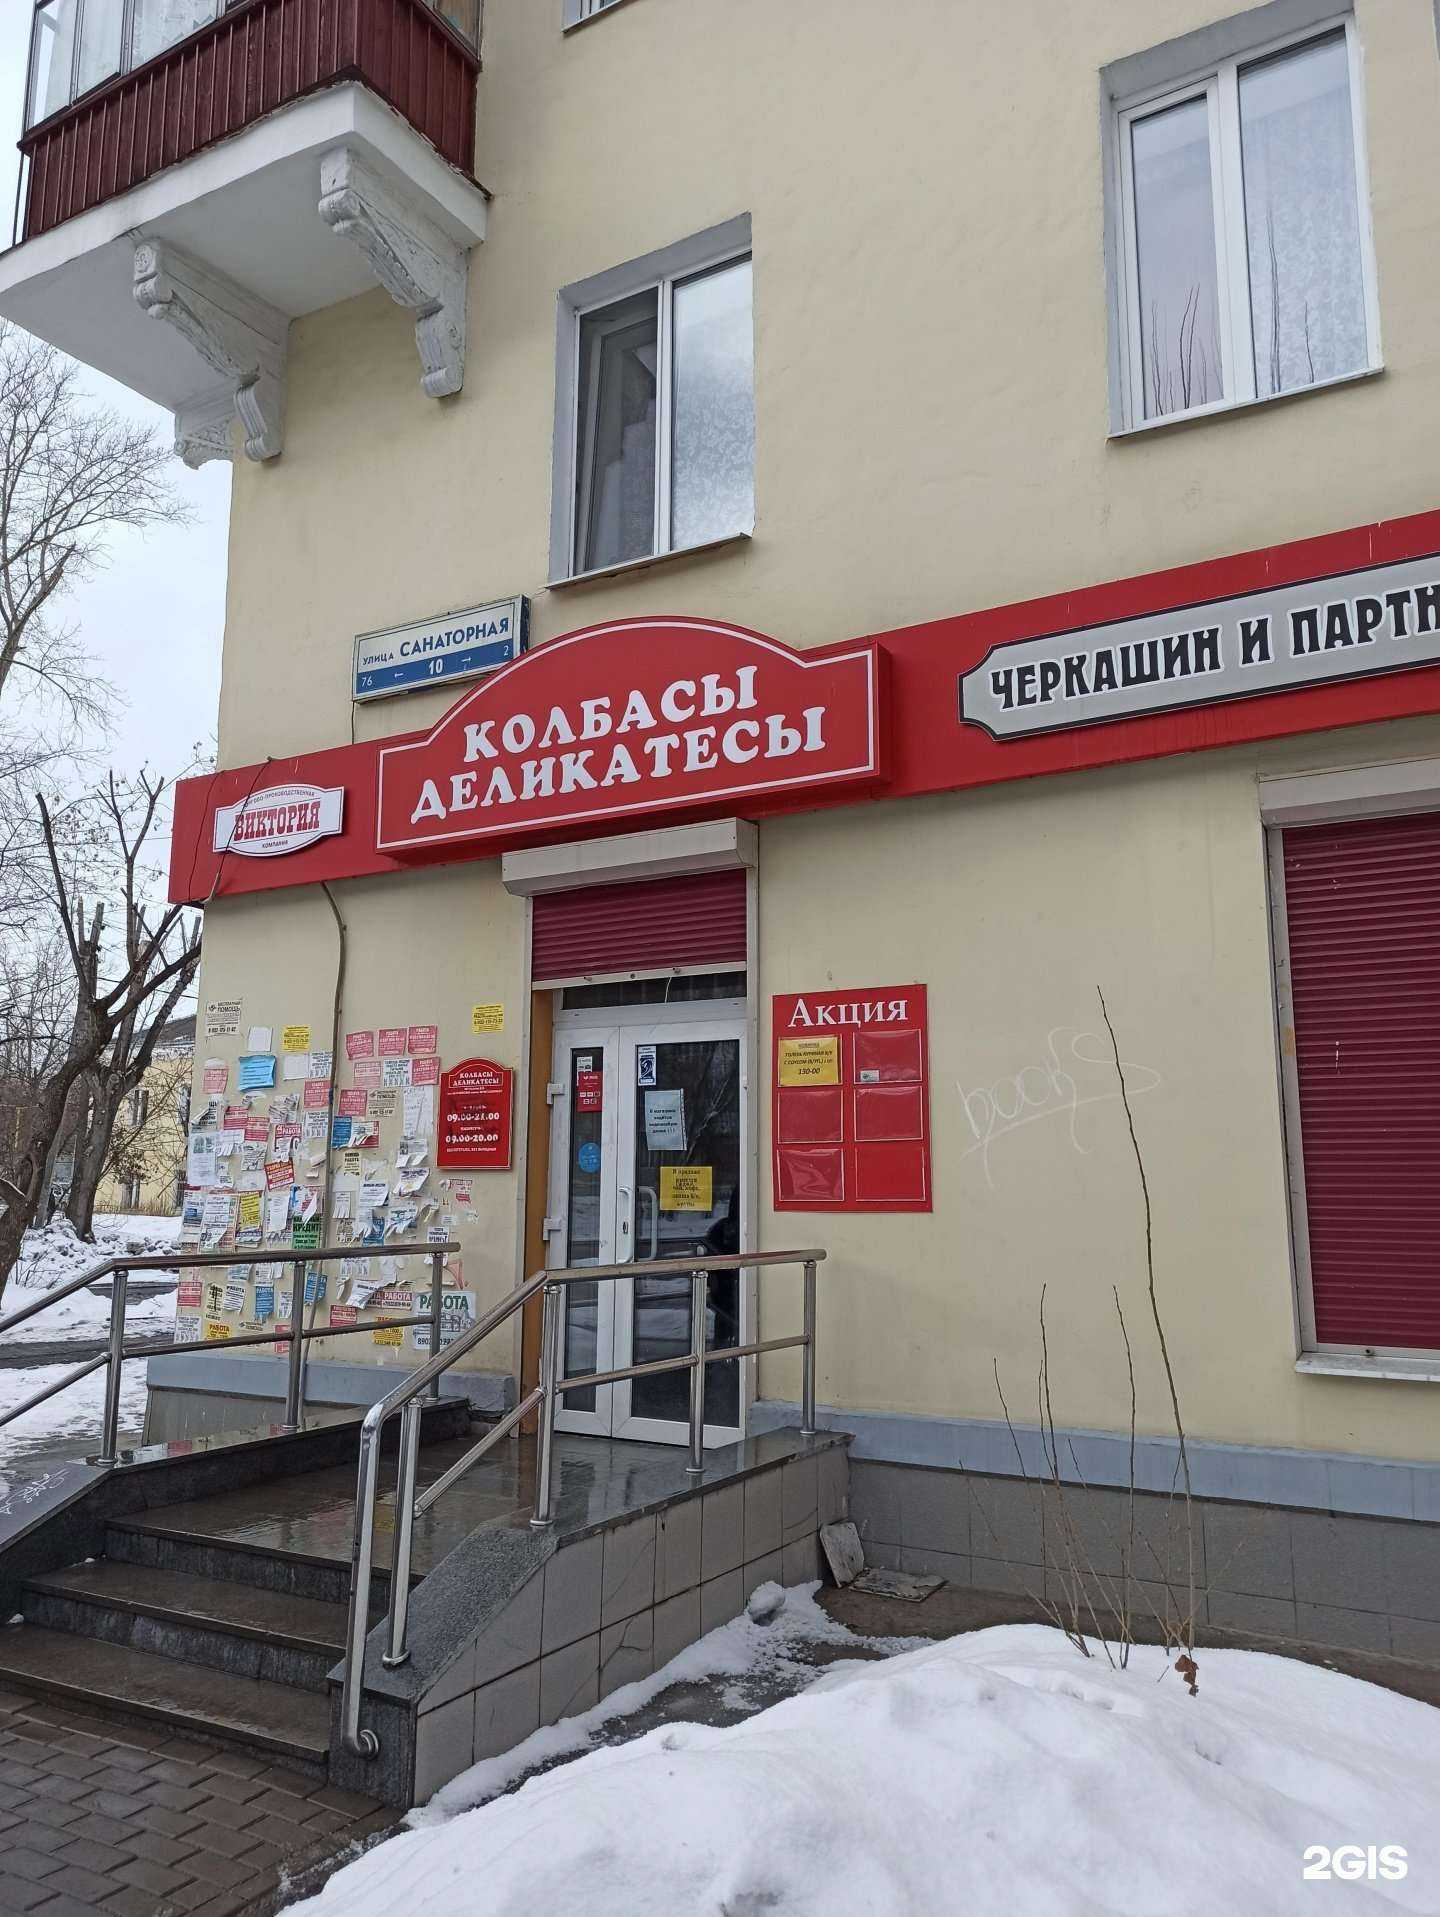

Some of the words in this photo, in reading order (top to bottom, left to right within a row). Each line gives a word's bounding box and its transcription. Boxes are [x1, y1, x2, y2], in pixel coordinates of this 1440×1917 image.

[362, 653, 394, 666] УЛИЦА
[400, 617, 509, 657] САНАТОРНАЯ
[992, 626, 1221, 710] ЧЕРКАШИН
[1239, 617, 1270, 664] И
[1291, 584, 1440, 656] ПАРТН
[361, 675, 373, 687] 76
[428, 658, 443, 675] 10
[503, 646, 509, 657] 2
[463, 665, 757, 763] КОЛБАСЫ
[410, 706, 827, 824] ДЕЛИКАТЕСЫ
[234, 801, 320, 841] ВИКТОРИЯ
[262, 840, 288, 849] КОМПАНИЯ
[788, 998, 908, 1028] Акция
[453, 1078, 499, 1086] ДЕЛИКАТЕСЫ
[460, 1071, 493, 1079] КОЛБАСЫ
[446, 1134, 498, 1143] 09.00-20.00
[293, 1223, 319, 1233] КРЕДИТ
[384, 1292, 412, 1301] РАБОТА
[420, 1295, 469, 1310] РАОТА
[210, 1324, 230, 1332] РАБОТА
